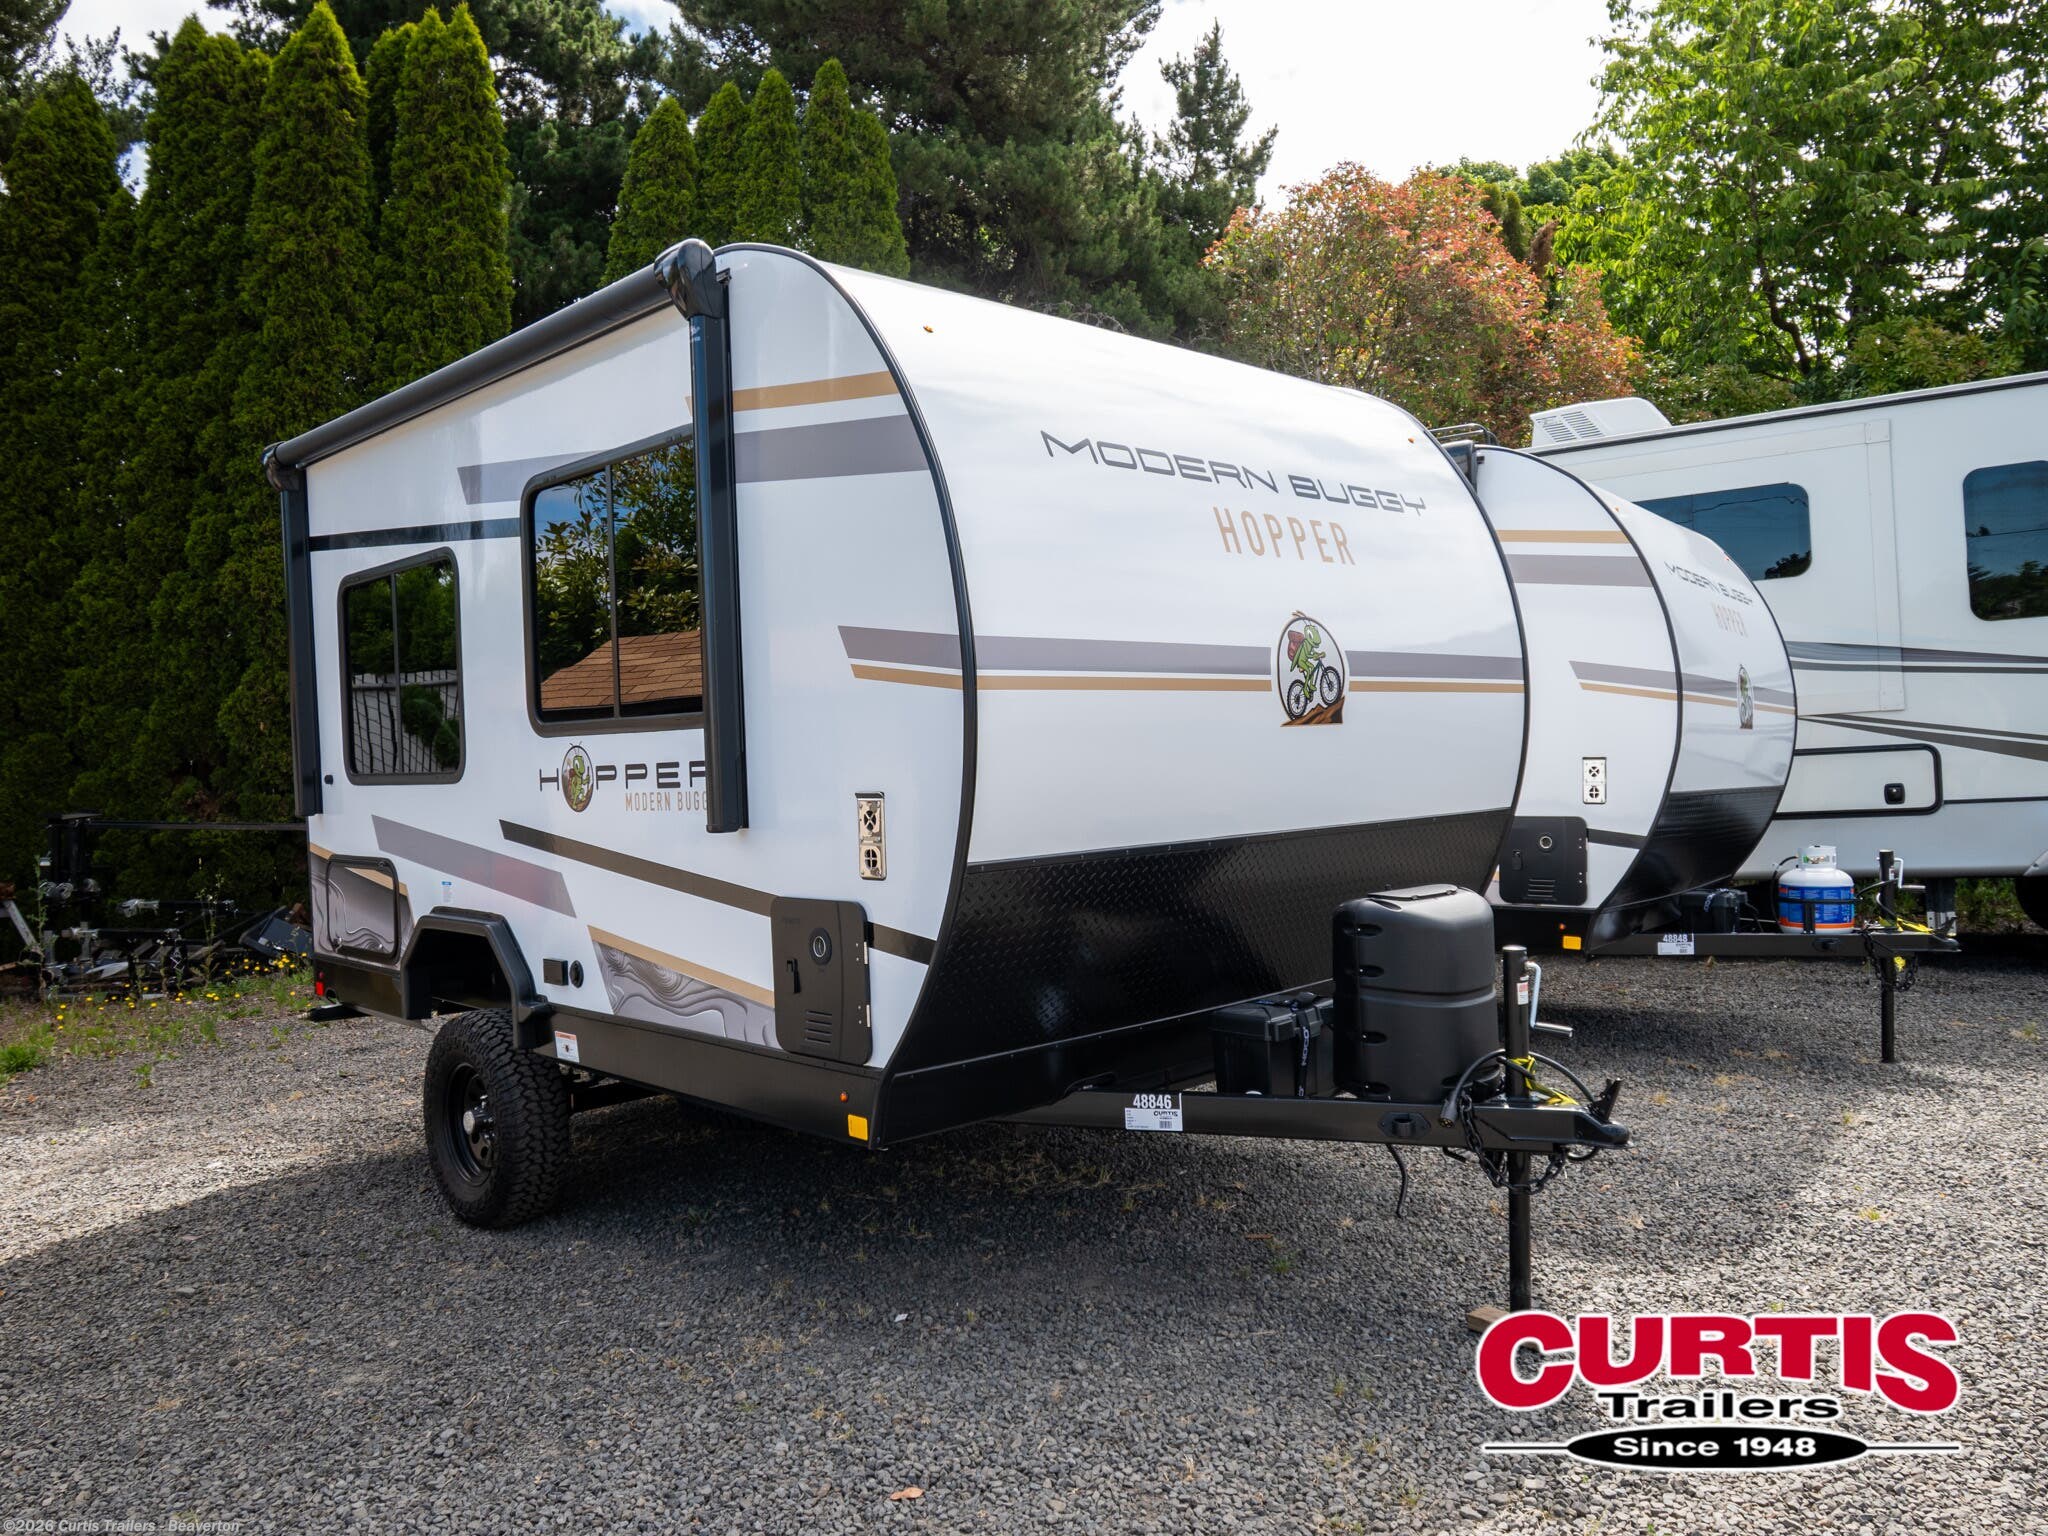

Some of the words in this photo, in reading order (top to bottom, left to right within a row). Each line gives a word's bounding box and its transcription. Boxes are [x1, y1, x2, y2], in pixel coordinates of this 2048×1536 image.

[1040, 430, 1279, 495] MODERN
[1287, 474, 1426, 516] BUGGY
[1213, 506, 1356, 566] HOPPER
[625, 792, 671, 812] MODERN
[677, 791, 708, 811] BUGG
[1133, 1094, 1172, 1109] 48846
